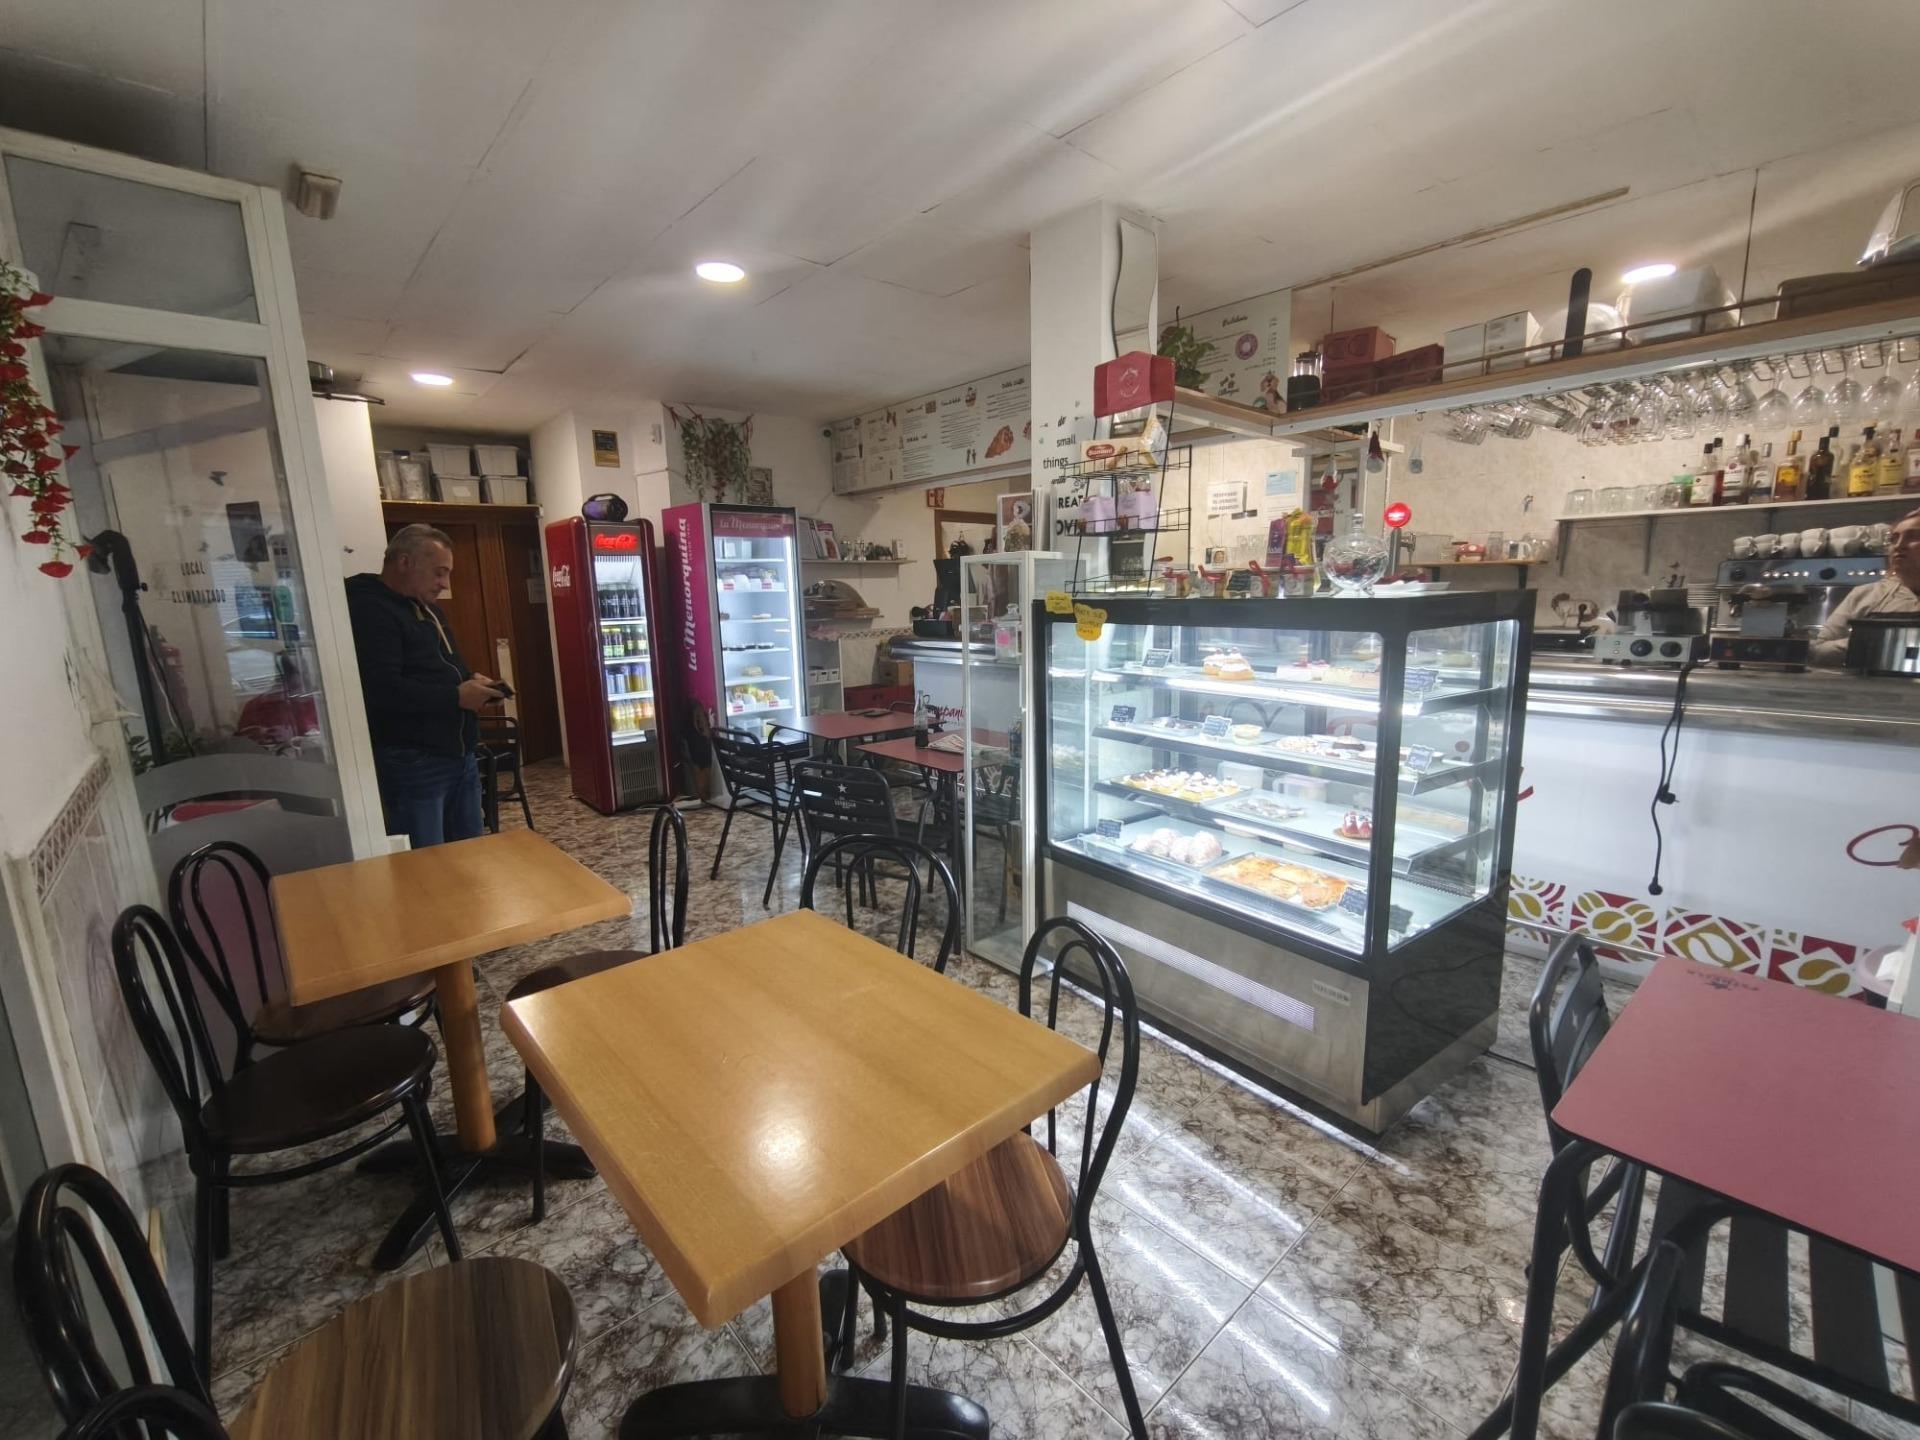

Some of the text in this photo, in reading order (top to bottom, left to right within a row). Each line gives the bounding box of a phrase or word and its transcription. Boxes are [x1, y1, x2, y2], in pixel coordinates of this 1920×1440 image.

[1056, 433, 1076, 448] small
[1042, 456, 1069, 472] things
[1058, 494, 1084, 509] REAT
[594, 533, 637, 550] Coca-Cola
[181, 560, 206, 576] LOCAL
[677, 517, 697, 649] Menorquina
[171, 589, 227, 604] CLIMATIZADO
